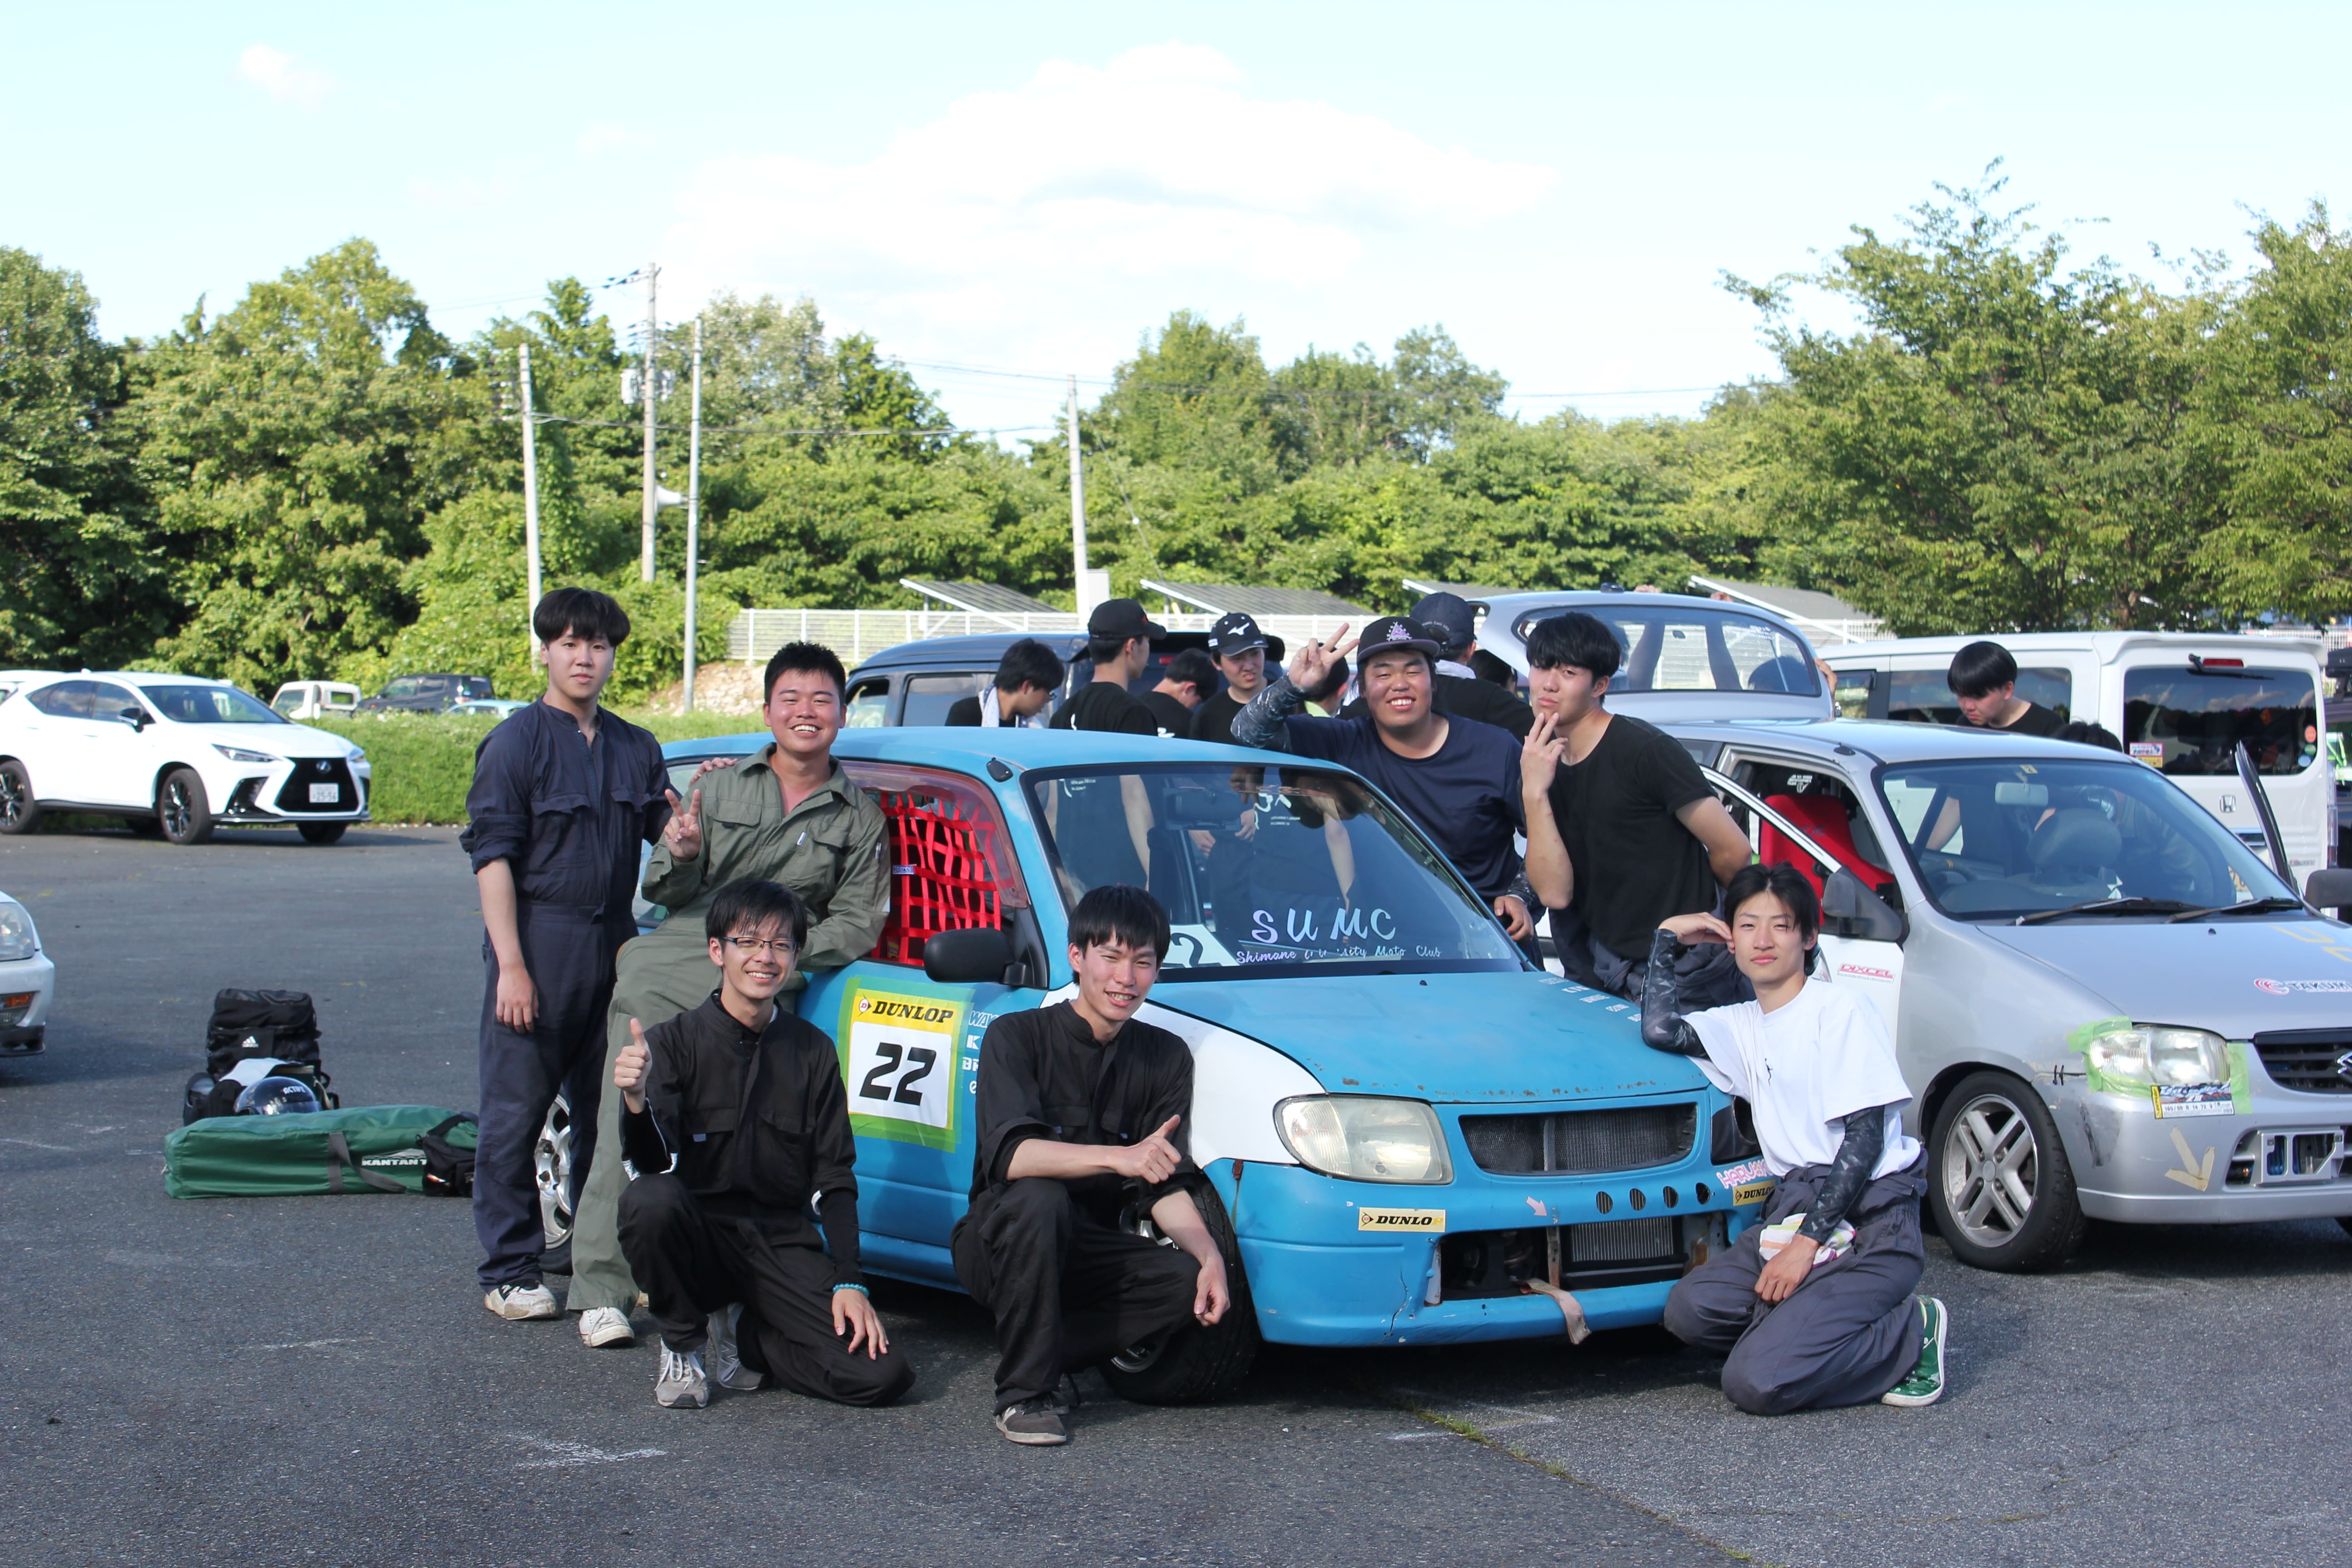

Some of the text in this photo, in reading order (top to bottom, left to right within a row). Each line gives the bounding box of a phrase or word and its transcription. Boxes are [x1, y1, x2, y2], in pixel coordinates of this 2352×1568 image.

[1236, 951, 1297, 964] Shimane
[1416, 945, 1442, 958] Club
[872, 1000, 954, 1023] DUNLOP
[859, 1042, 936, 1106] 22
